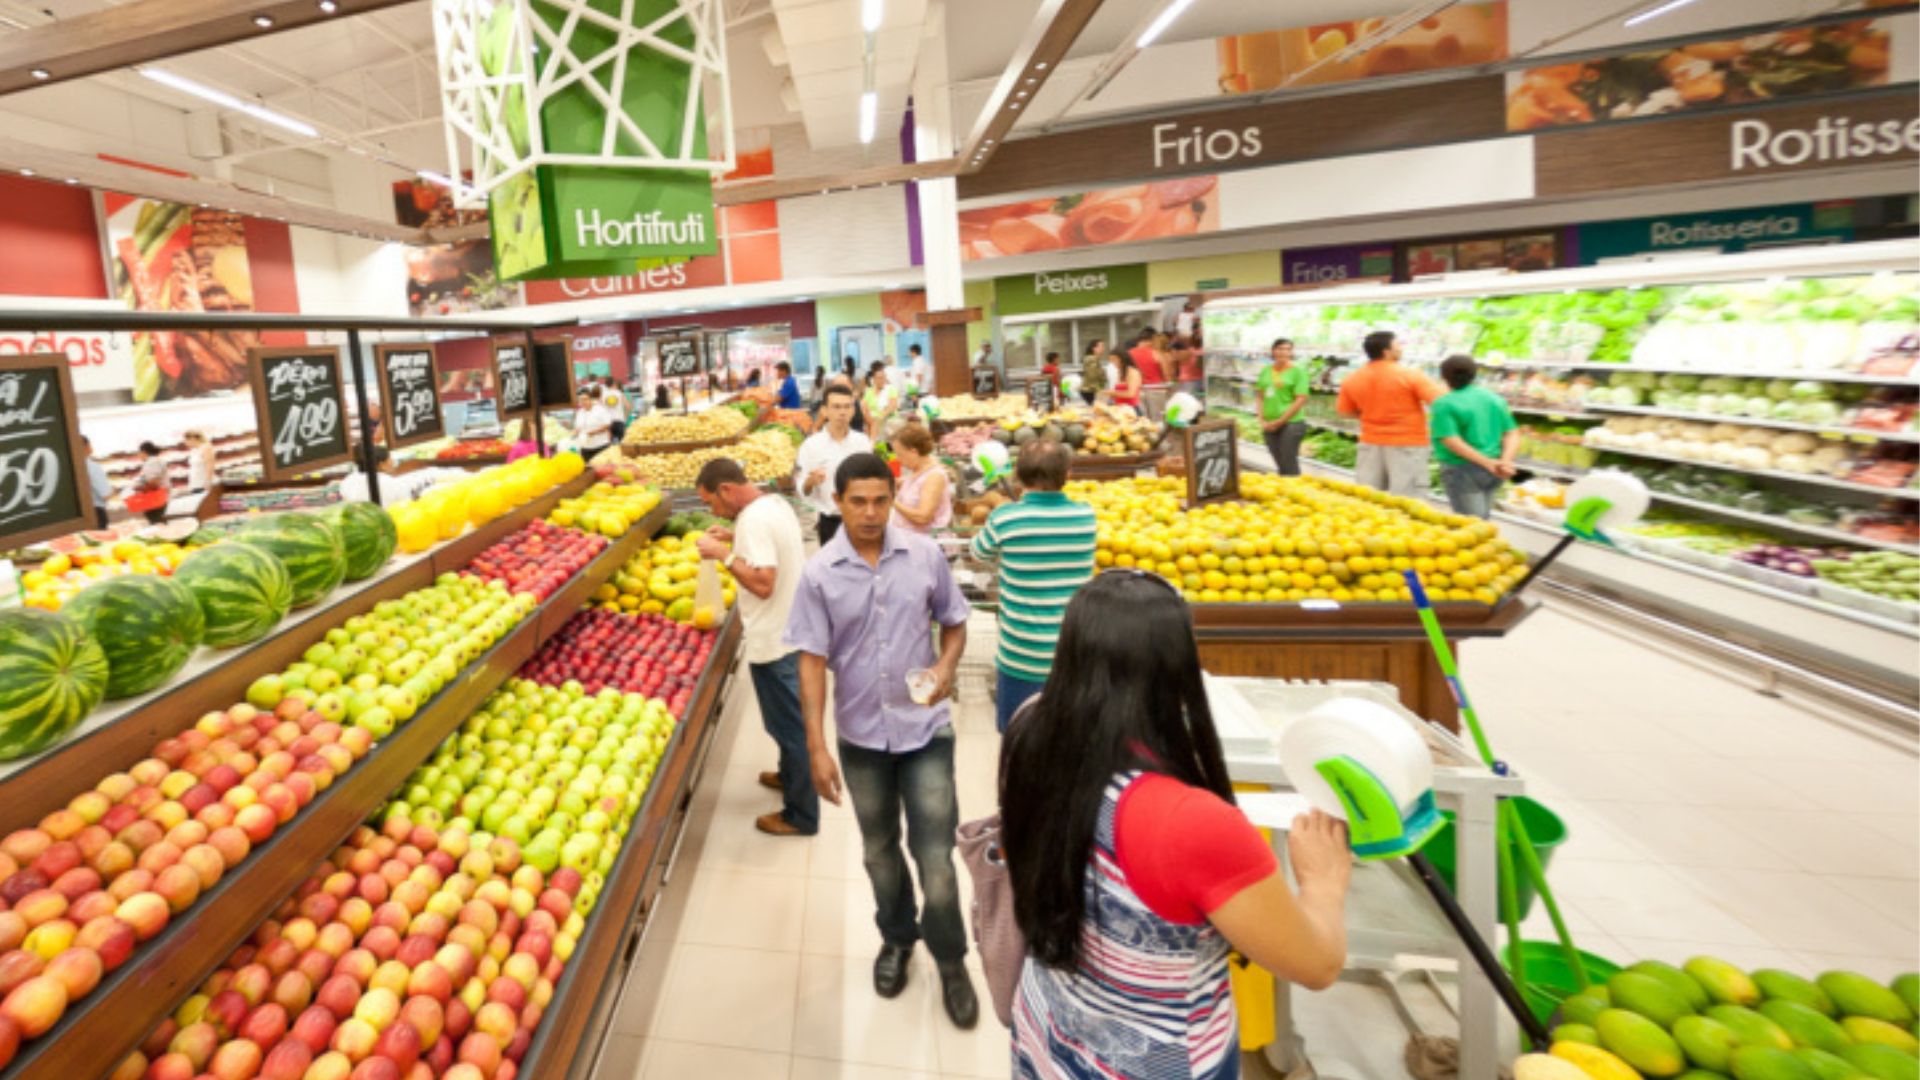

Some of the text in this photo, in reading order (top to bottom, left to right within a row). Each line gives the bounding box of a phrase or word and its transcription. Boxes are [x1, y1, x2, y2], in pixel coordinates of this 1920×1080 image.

[1153, 123, 1263, 168] Frios
[574, 208, 706, 247] Hortifruti
[1650, 216, 1799, 246] Rotisseria
[1034, 272, 1109, 296] Peixes
[1292, 262, 1348, 284] Frios
